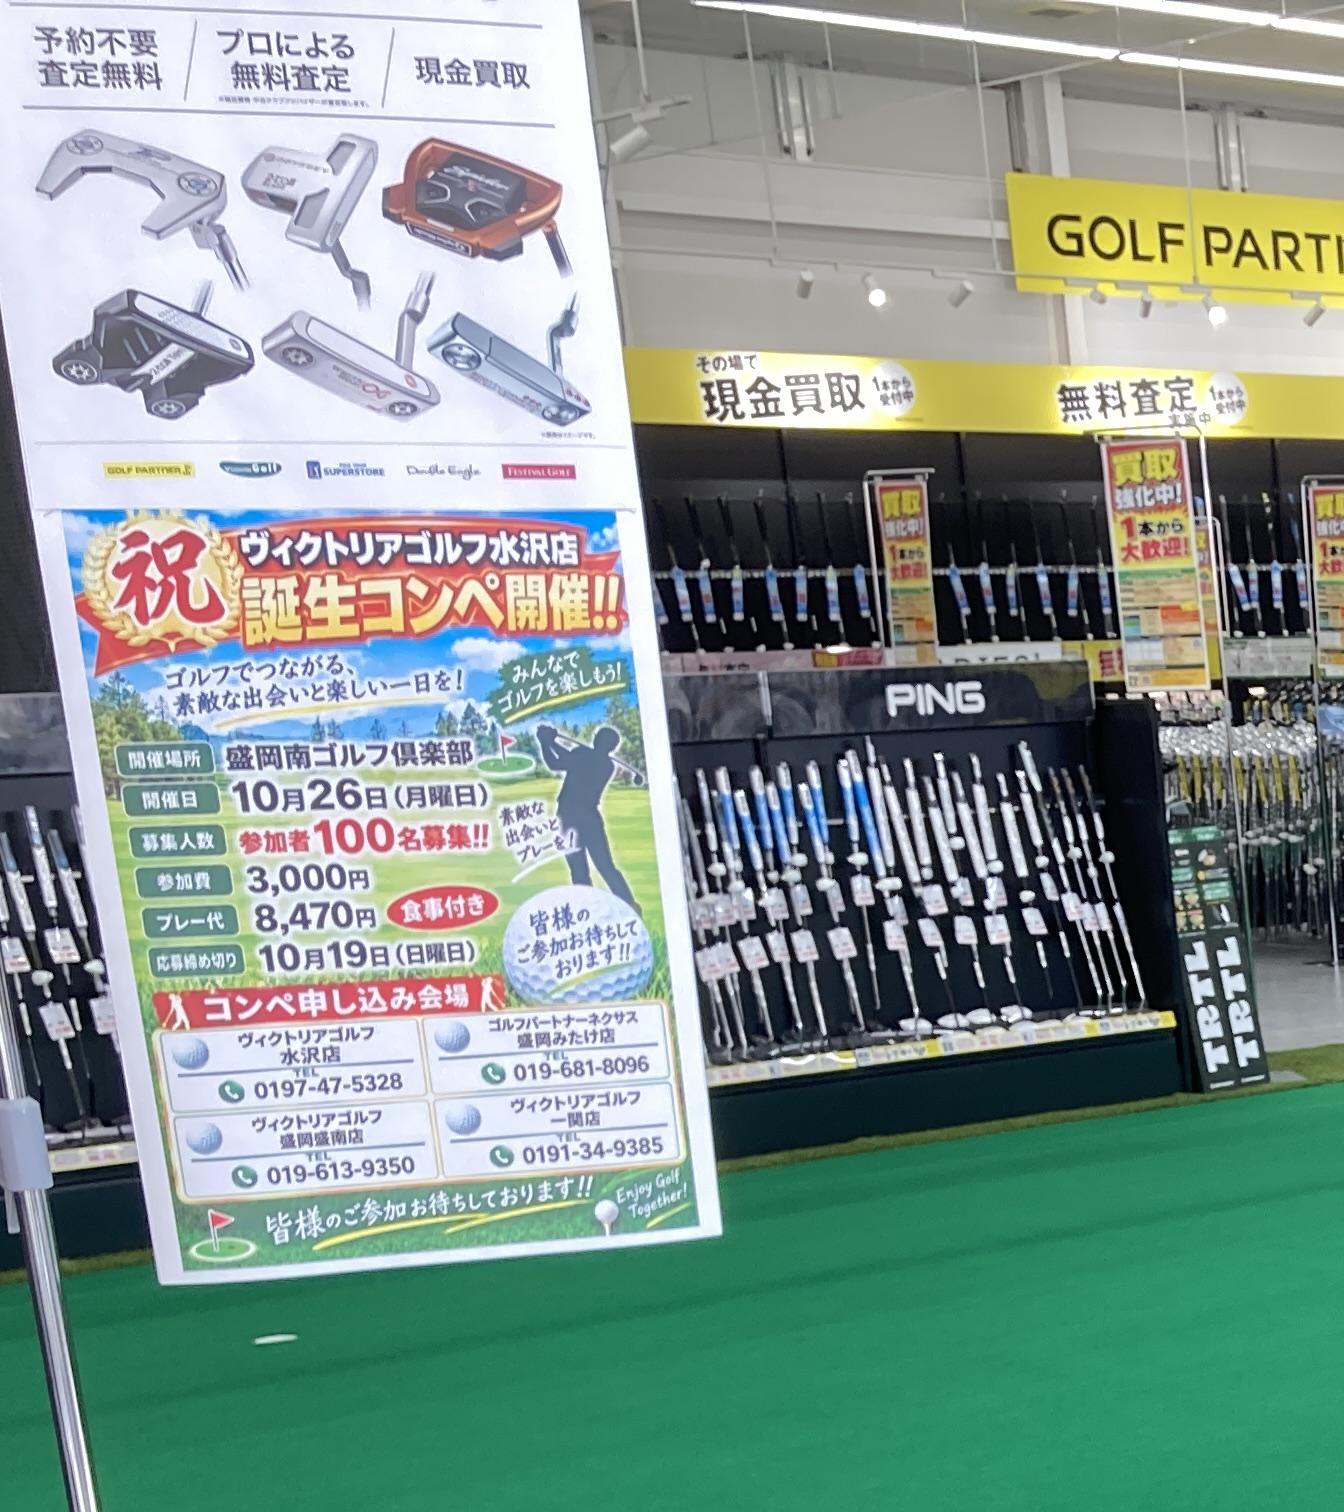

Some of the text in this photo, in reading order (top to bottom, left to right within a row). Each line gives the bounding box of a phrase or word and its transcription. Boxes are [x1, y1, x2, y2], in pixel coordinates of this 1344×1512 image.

[33, 27, 158, 58] 予約不要
[215, 30, 355, 60] プロによる
[38, 60, 163, 91] 査定無料
[231, 64, 349, 93] 無料査定
[415, 56, 531, 89] 現金買取
[1047, 213, 1185, 263] GOLF
[697, 353, 757, 371] その場で
[701, 373, 866, 422] 現金買取
[1058, 377, 1197, 422] 無料査定
[1112, 448, 1179, 484] 買取
[1115, 483, 1182, 510] 強化中!
[1121, 517, 1183, 541] 1本から
[239, 531, 579, 567] ヴィクトリアゴルフ水沢店
[1121, 537, 1190, 563] 大歓迎!
[111, 528, 226, 627] 祝
[241, 572, 621, 647] 誕生コンペ開催!!
[166, 657, 356, 690] ゴルフでつながる、
[511, 651, 579, 684] みんなで
[176, 670, 464, 715] 素敵な出会いと楽しい一日を!
[498, 661, 621, 713] ゴルフを楽しもう!
[885, 681, 985, 716] PING
[128, 750, 201, 770] 開催場所
[226, 741, 474, 772] 盛岡南ゴルフ倶楽部
[142, 791, 199, 811] 開催日
[501, 802, 545, 826] 素敵な
[141, 830, 214, 851] 募集人数
[239, 818, 489, 855] 参加者100名募集!!
[505, 817, 559, 846] 出会いと
[157, 871, 211, 893] 参加費
[246, 864, 370, 894] 3,000円
[157, 912, 225, 933] プレー代
[253, 903, 376, 934] 8,470円
[400, 894, 486, 922] 食事付き
[528, 907, 590, 932] 皆様の
[516, 918, 640, 965] ご参加お待ちして
[157, 951, 237, 973] 応募締め切り
[204, 984, 469, 1022] コンペ申し込み会場
[1184, 940, 1230, 1074] TRTL
[1216, 936, 1260, 1068] TRTL
[488, 1011, 638, 1032] ゴルフパートナーネクサス
[238, 1025, 374, 1049] ヴィクトリアゴルフ
[516, 1027, 615, 1049] 盛岡みたけ店
[280, 1046, 341, 1065] 水沢店
[514, 1056, 650, 1083] 019-681-8096
[254, 1073, 403, 1099] 0197-47-5328
[510, 1089, 641, 1113] ヴィクトリアゴルフ
[252, 1108, 382, 1133] ヴィクトリアゴルフ
[551, 1110, 600, 1128] 一関店
[280, 1129, 364, 1149] 盛岡盛南店
[522, 1137, 664, 1164] 0191-34-9385
[267, 1156, 415, 1185] 019-613-9350
[615, 1170, 681, 1204] Enjoy Golf
[627, 1183, 688, 1218] Together!
[266, 1176, 594, 1246] 皆様のご参加お待ちしております!!
